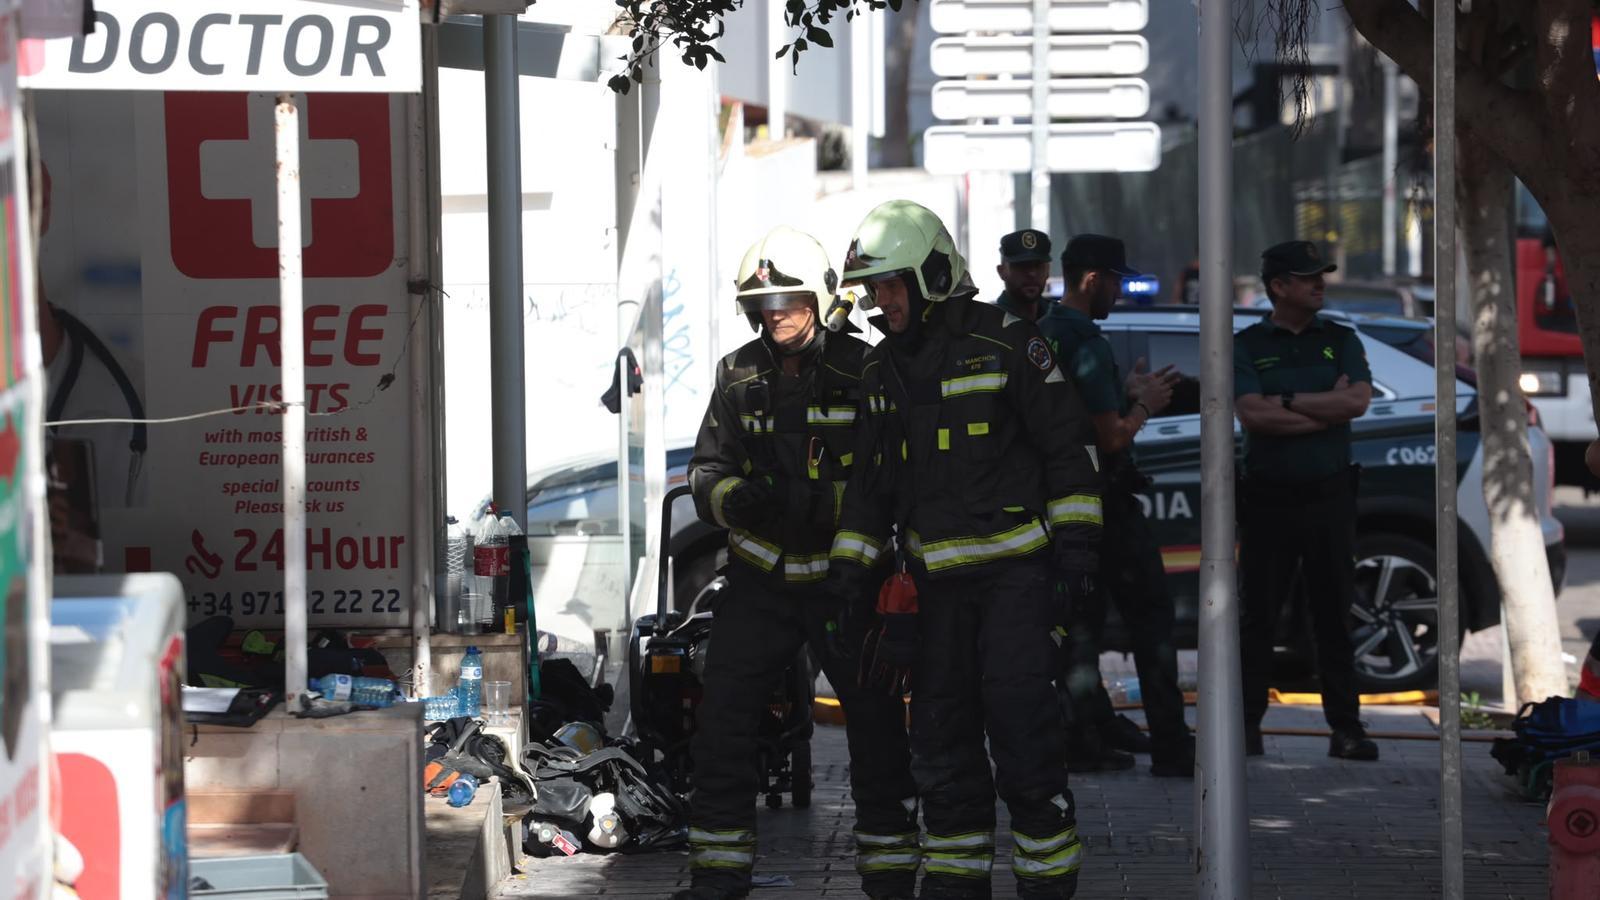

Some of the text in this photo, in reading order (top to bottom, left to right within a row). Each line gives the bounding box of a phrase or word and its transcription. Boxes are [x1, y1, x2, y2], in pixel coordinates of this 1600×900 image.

[68, 11, 391, 77] DOCTOR
[191, 304, 388, 368] FREE
[230, 383, 351, 415] VISTS
[205, 427, 368, 444] with mos ritish &
[199, 451, 279, 468] European
[222, 480, 360, 496] special counts
[305, 500, 321, 513] sk
[326, 501, 344, 513] us
[233, 528, 404, 572] 24 Hour
[187, 589, 400, 616] +34 971 2 22 22
